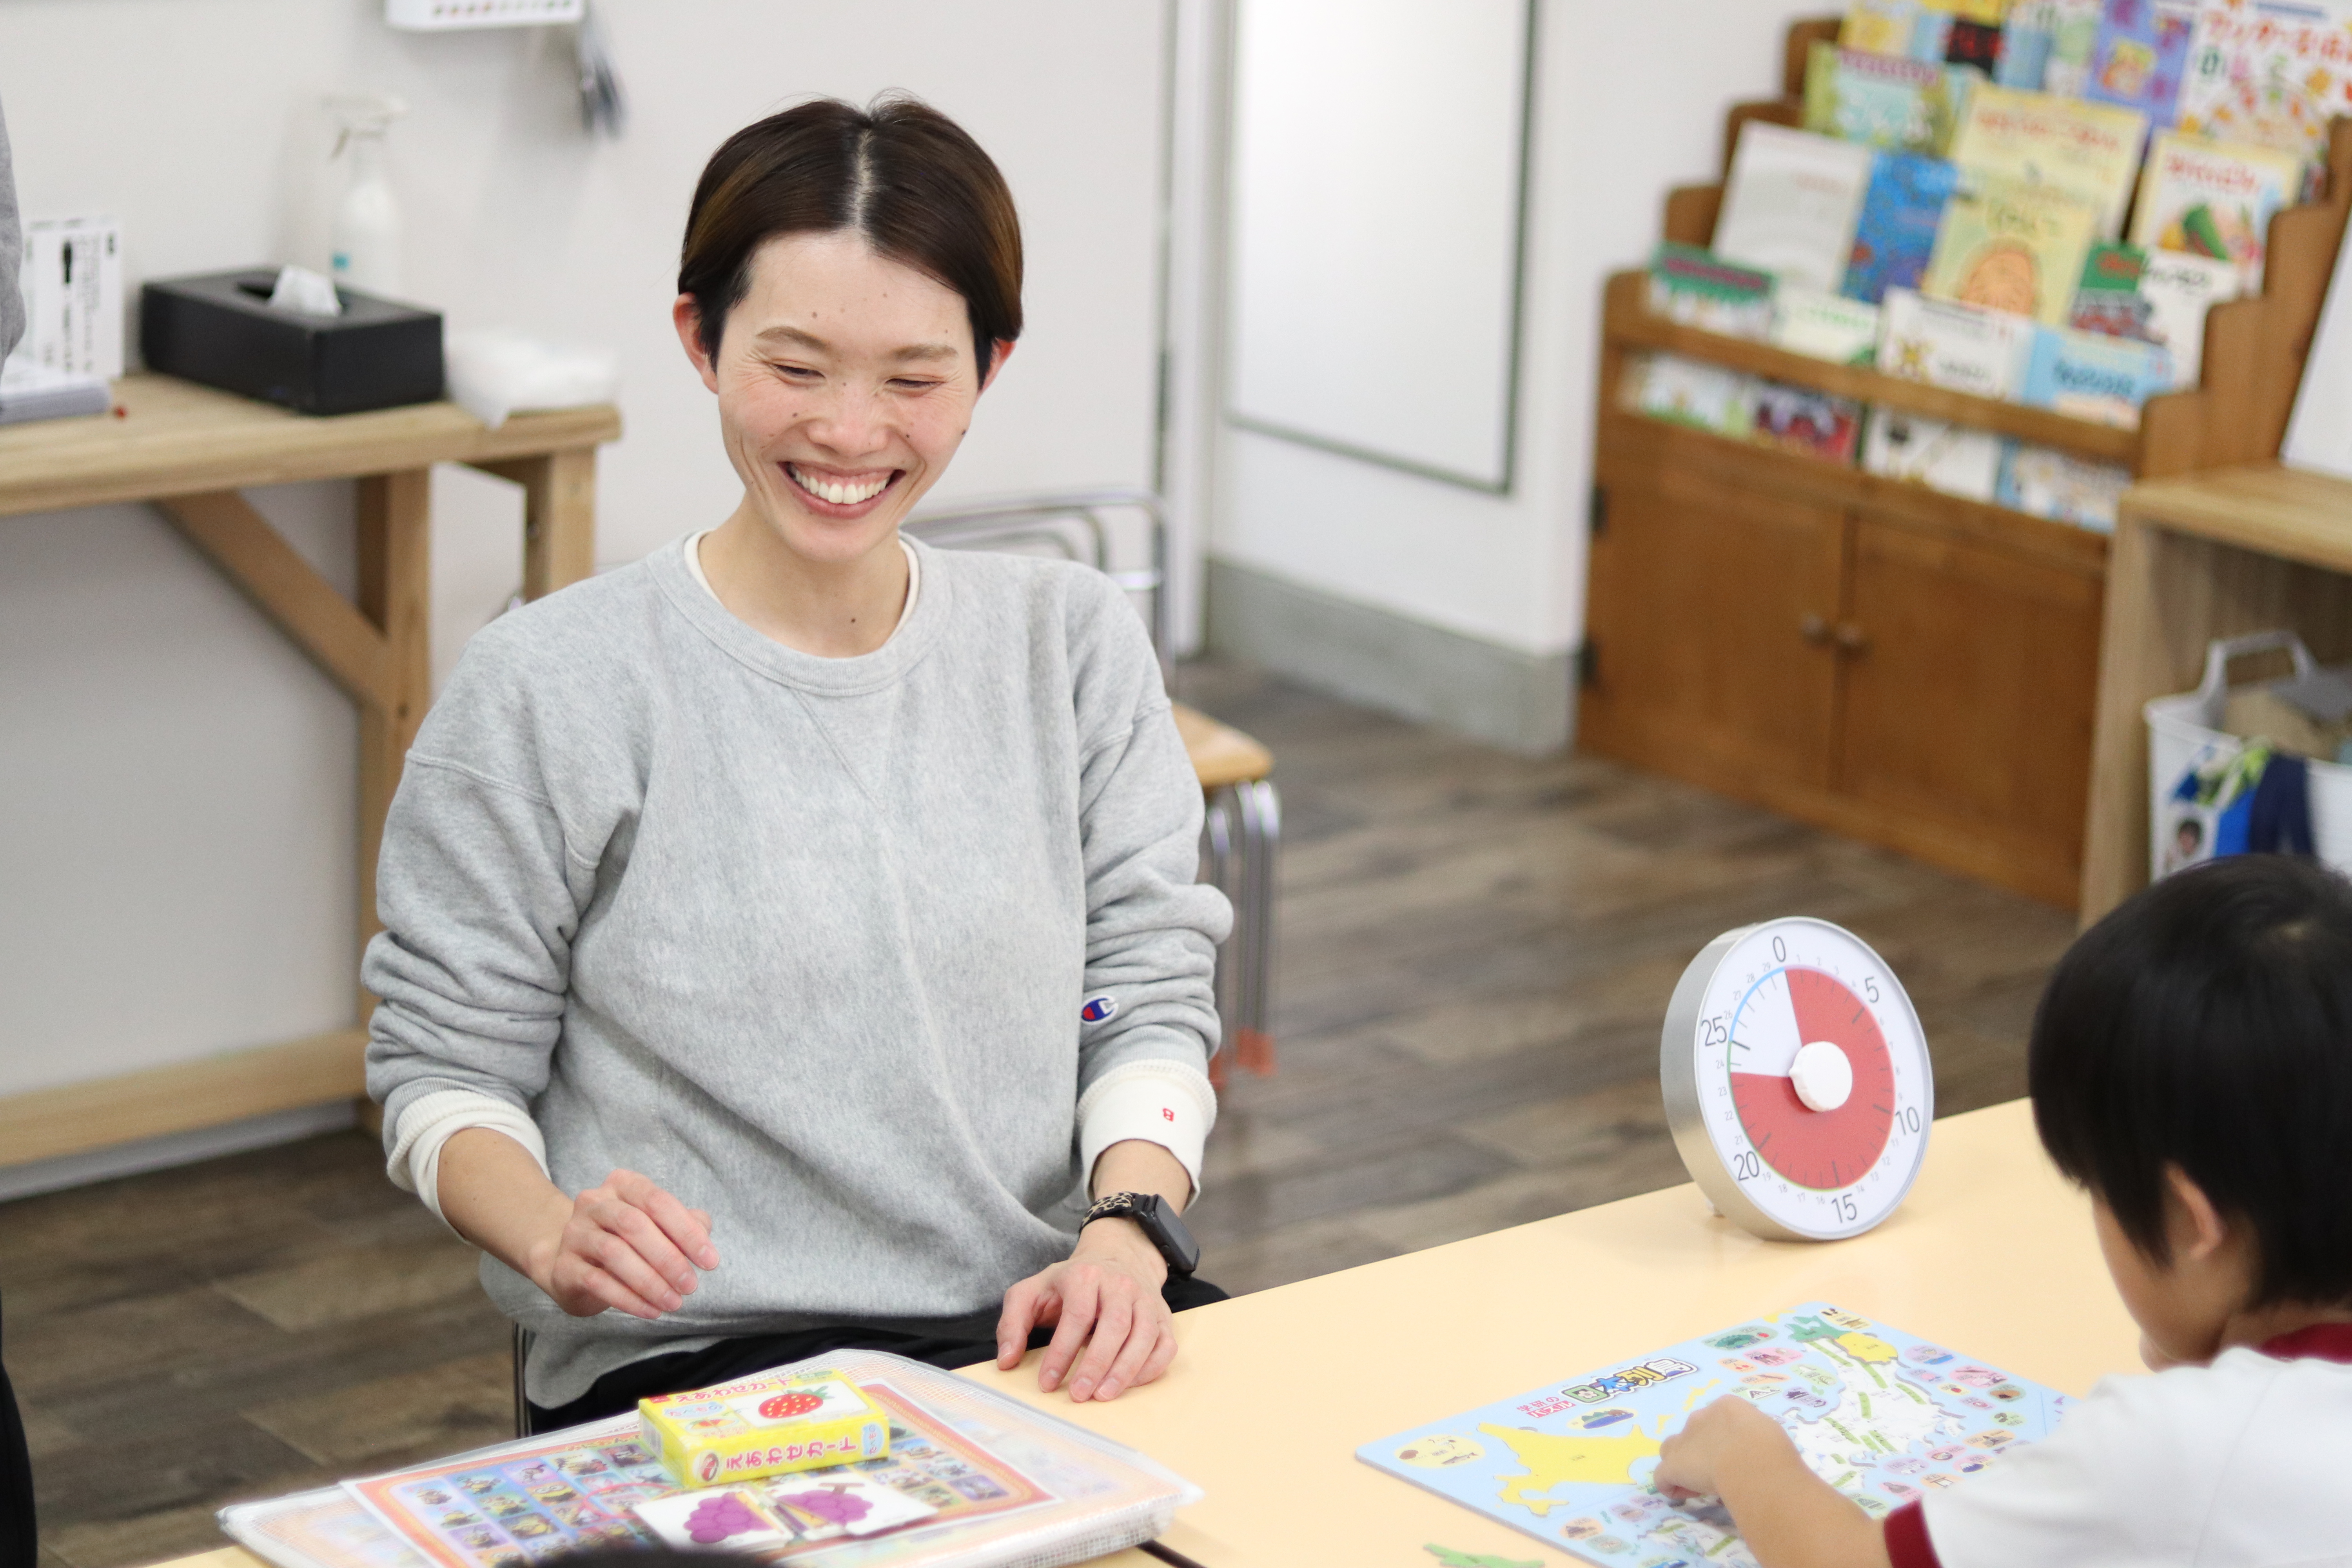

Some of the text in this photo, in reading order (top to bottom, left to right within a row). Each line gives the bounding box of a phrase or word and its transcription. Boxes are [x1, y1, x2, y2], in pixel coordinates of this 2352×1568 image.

[1772, 936, 1786, 962] 0
[1816, 956, 1821, 965] 2
[1762, 962, 1771, 971] 29
[1746, 972, 1755, 983] 28
[1733, 989, 1741, 1000] 27
[1864, 976, 1879, 1003] 5
[1724, 1009, 1733, 1020] 26
[1700, 1016, 1727, 1047] 25
[1716, 1060, 1724, 1069] 24
[1718, 1087, 1728, 1096] 23
[1725, 1111, 1734, 1121] 22
[1895, 1107, 1920, 1136] 10
[1890, 1138, 1899, 1147] 11
[1733, 1151, 1760, 1182] 20
[1882, 1156, 1891, 1166] 12
[1762, 1171, 1772, 1181] 19
[1870, 1172, 1880, 1181] 13
[1779, 1183, 1788, 1193] 18
[1857, 1185, 1865, 1193] 14
[1797, 1192, 1806, 1203] 17
[1816, 1196, 1826, 1205] 16
[1831, 1193, 1857, 1224] 15
[1561, 1358, 1694, 1403] 日本列島
[675, 1377, 793, 1403] えあわせカード
[1516, 1396, 1560, 1413] 学研の
[1530, 1400, 1573, 1418] パズル
[726, 1436, 857, 1470] えあわせカード
